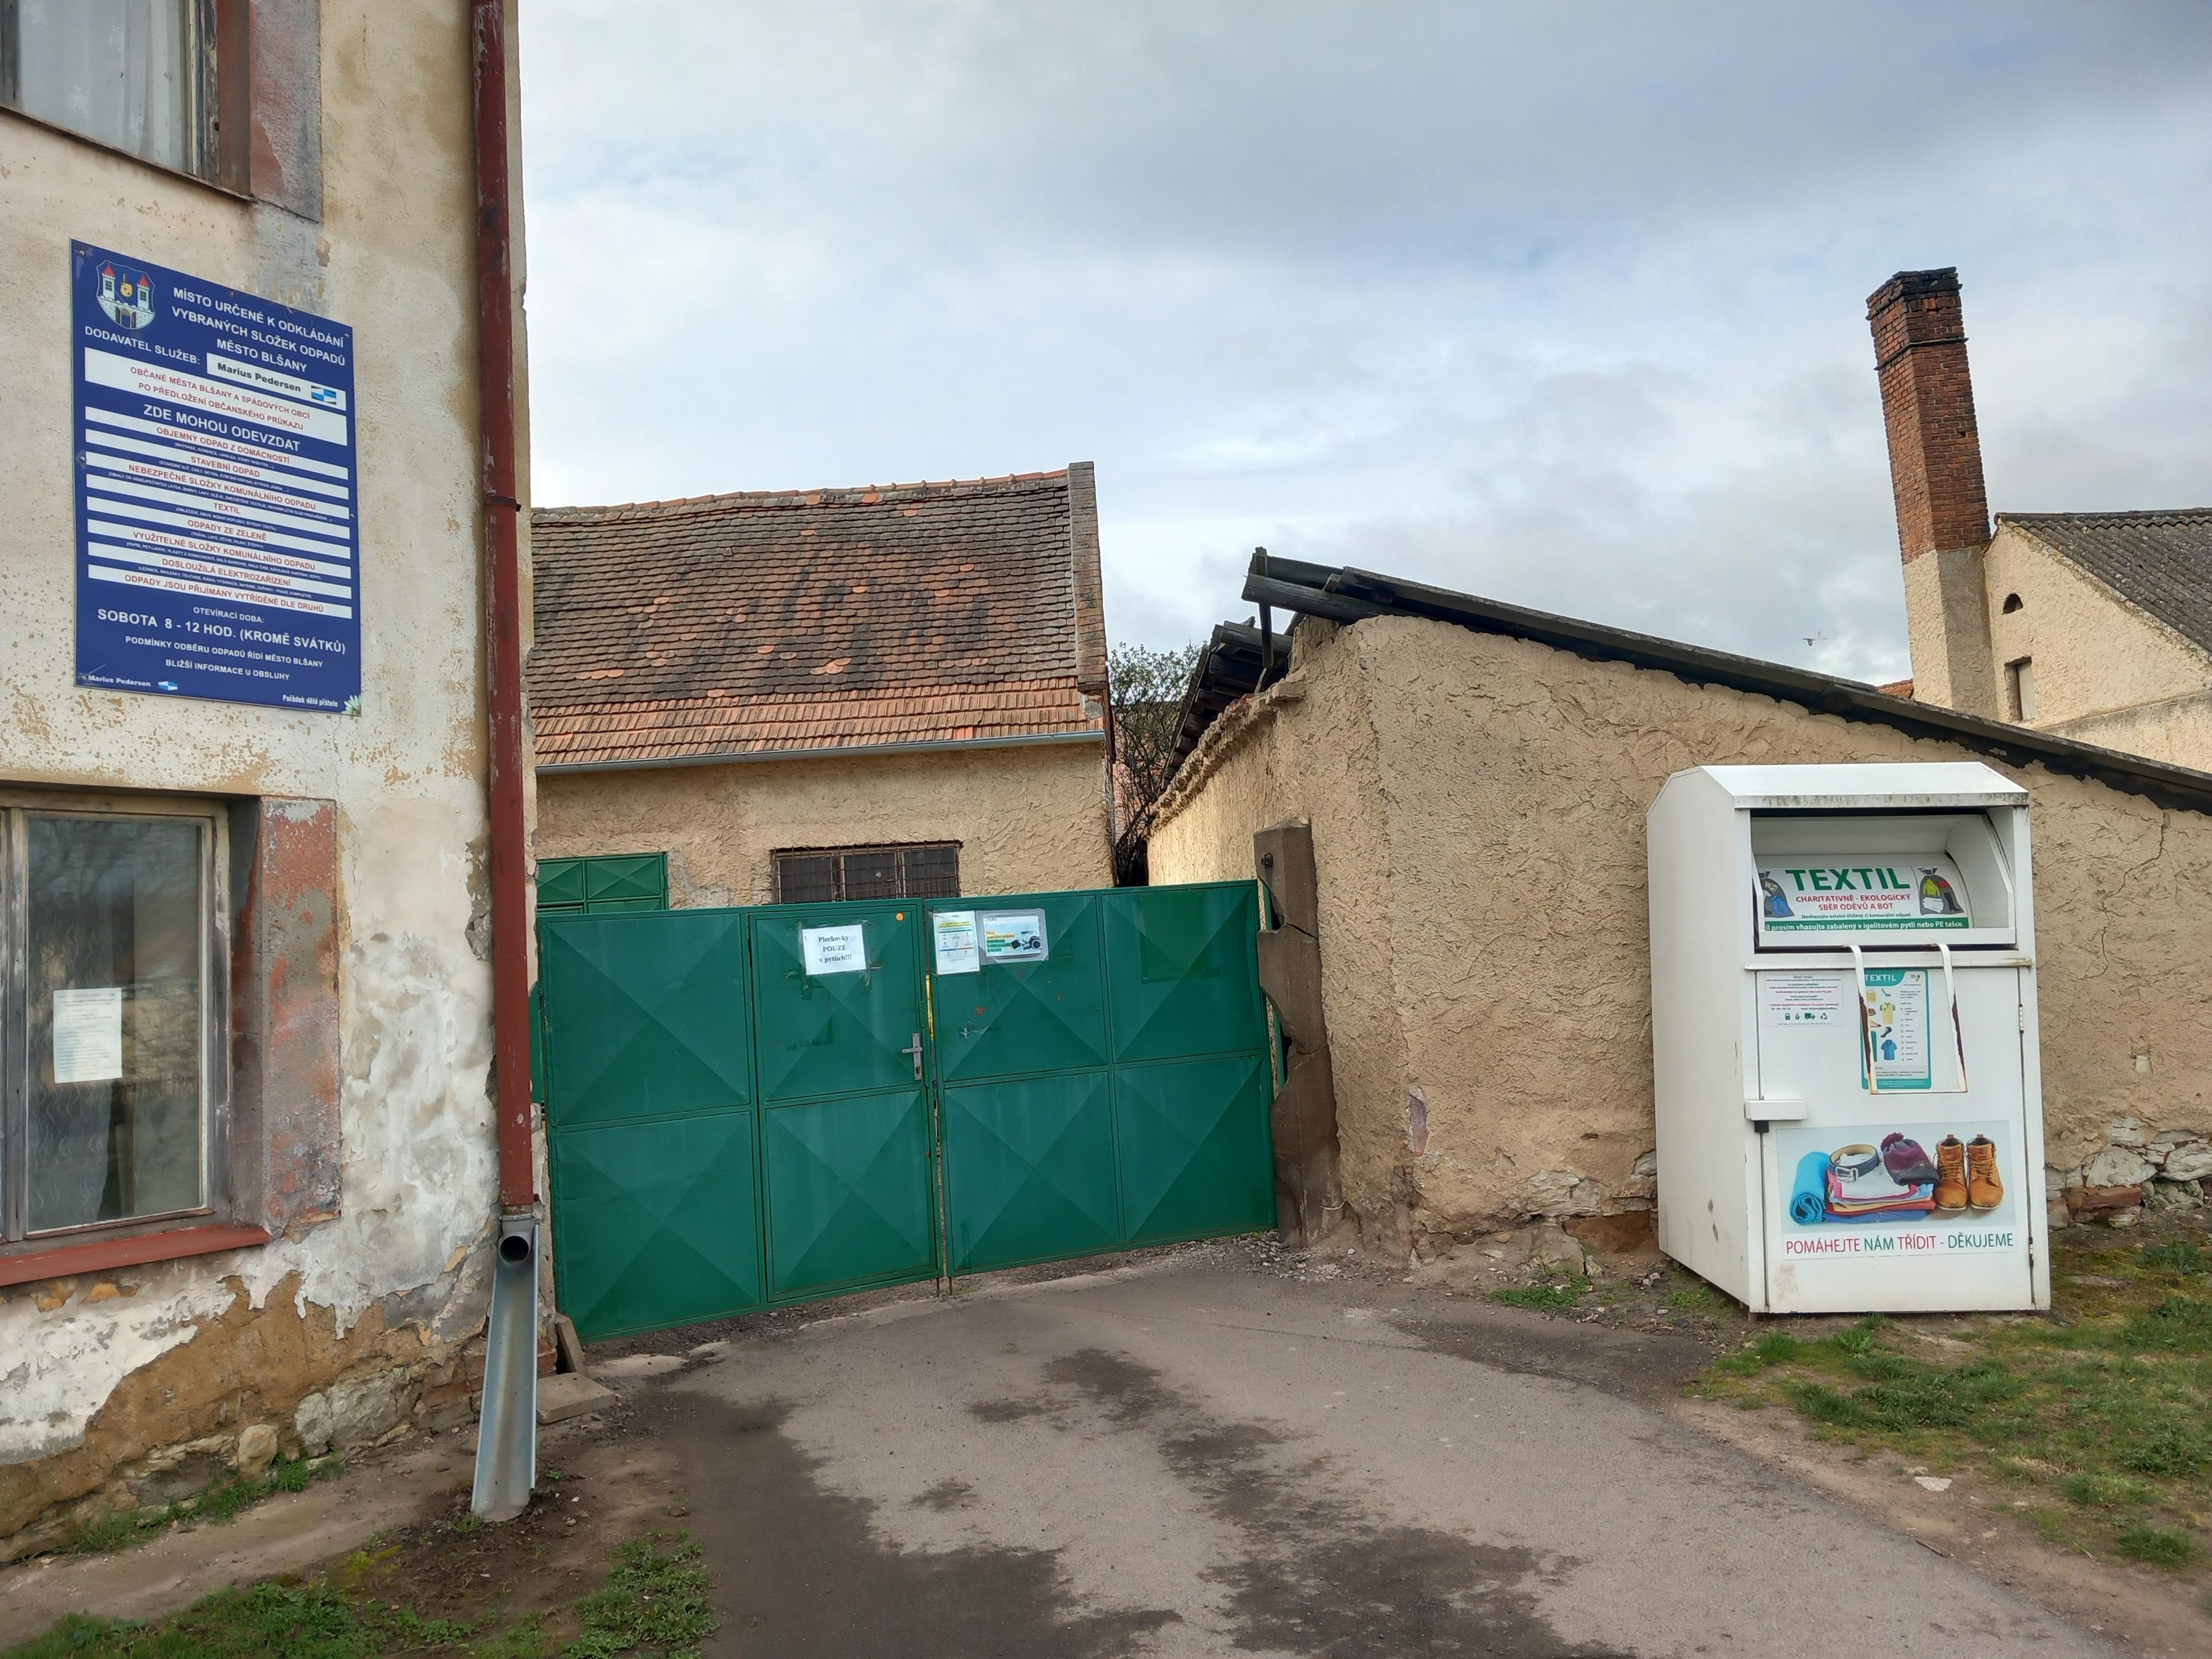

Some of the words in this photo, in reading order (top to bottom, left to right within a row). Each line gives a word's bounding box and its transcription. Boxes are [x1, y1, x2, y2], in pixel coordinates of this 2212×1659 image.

[171, 305, 248, 337] VYBRANÝCH
[251, 329, 297, 352] SLOŽEK
[173, 286, 212, 307] MÍSTO
[214, 299, 264, 324] URČENÉ
[267, 315, 275, 327] K
[278, 319, 343, 348] ODKLÁDÁNÍ
[84, 325, 152, 352] DODAVATEL
[154, 344, 200, 365] SLUŽEB:
[216, 338, 258, 359] MĚSTO
[260, 351, 307, 372] BLŠANY
[129, 366, 167, 382] OBČANÉ
[169, 376, 197, 390] MĚSTA
[199, 384, 232, 399] BLŠANY
[241, 395, 289, 414] SPÁDOVÝCH
[290, 408, 310, 419] OBCÍ
[217, 362, 252, 379] Marius
[254, 372, 301, 393] Pedersen
[138, 382, 151, 391] PO
[153, 385, 206, 405] PŘEDLOŽENÍ
[207, 399, 265, 420] OBČANSKÉHO
[266, 414, 303, 430] PRŮKAZU
[143, 403, 172, 421] ZDE
[175, 411, 227, 434] MOHOU
[231, 425, 300, 451] ODEVZDAT
[156, 426, 197, 442] OBJEMNÝ
[199, 436, 228, 450] ODPAD
[237, 445, 290, 464] DOMÁCNOSTÍ
[190, 455, 231, 471] STAVEBNÍ
[232, 465, 260, 477] ODPAD
[128, 463, 186, 483] NEBEZPEČNÉ
[188, 476, 222, 490] SLOŽKY
[223, 484, 283, 503] KOMUNÁLNÍHO
[284, 497, 316, 510] ODPADU
[212, 502, 241, 514] TEXTIL
[187, 519, 222, 532] ODPADY
[223, 526, 234, 535] ZE
[132, 530, 186, 547] VYUŽITELNÉ
[187, 540, 221, 553] SLOŽKY
[222, 547, 283, 565] KOMUNÁLNÍHO
[283, 558, 315, 571] ODPADU
[161, 557, 216, 573] DOSLOUŽILÁ
[217, 567, 291, 586] ELEKTROZAŘÍZENÍ
[124, 573, 161, 586] ODPADY
[163, 580, 186, 591] JSOU
[187, 583, 232, 598] PŘIJÍMÁNY
[233, 591, 279, 606] VYTŘÍDĚNÉ
[280, 598, 295, 608] DLE
[297, 601, 324, 613] DRUHŮ
[192, 606, 238, 619] OTEVÍRACÍ
[238, 613, 264, 623] DOBA:
[97, 608, 158, 627] SOBOTA
[164, 617, 173, 629] 8
[184, 620, 200, 633] 12
[203, 623, 236, 638] HOD.
[239, 628, 290, 645] (KROMĚ
[293, 635, 346, 655] SVÁTKŮ)
[125, 635, 172, 648] PODMÍNKY
[173, 641, 210, 653] ODBĚRU
[247, 650, 263, 660] ŘÍDÍ
[264, 653, 292, 664] MĚSTO
[293, 657, 323, 667] BLŠANY
[87, 674, 114, 683] Marius
[115, 677, 151, 687] Pedersen
[165, 659, 193, 669] BLIŽŠÍ
[194, 662, 243, 675] INFORMACE
[252, 669, 290, 680] OBSLUHY
[281, 693, 305, 703] Pořádek
[305, 696, 319, 705] dělá
[318, 698, 338, 707] přátele
[1785, 868, 1911, 891] TEXTIL
[1796, 894, 1854, 902] CHARITATIVNĚ
[1840, 902, 1868, 910] ODĚVŮ
[1786, 1237, 1860, 1254] POMÁHEJTE
[1864, 1235, 1894, 1251] NÁM
[1897, 1234, 1936, 1250] TŘÍDIT
[1948, 1232, 2014, 1248] DĚKUJEME
